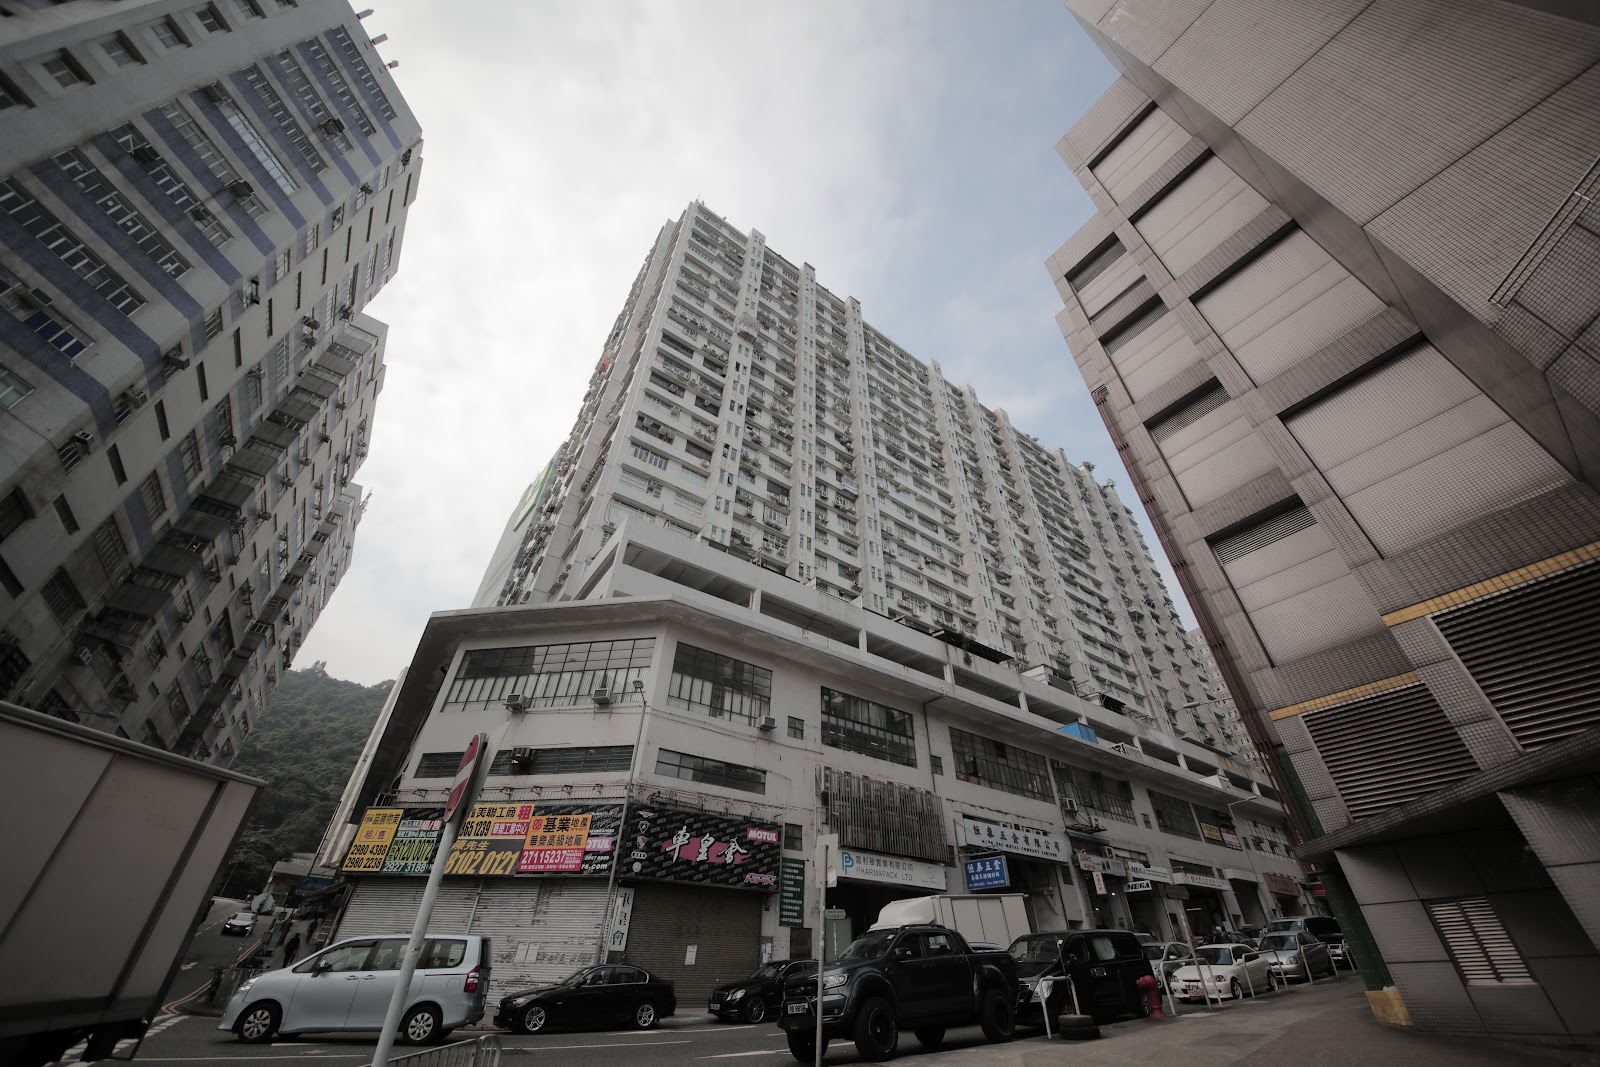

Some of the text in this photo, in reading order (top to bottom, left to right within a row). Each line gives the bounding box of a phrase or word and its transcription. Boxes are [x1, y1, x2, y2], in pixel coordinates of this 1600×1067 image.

[476, 807, 517, 818] 美聯工商
[518, 805, 532, 821] 租
[542, 816, 589, 833] 基業地產
[748, 830, 777, 841] MOTUL
[350, 844, 370, 856] 2980
[585, 839, 610, 849] OTUL
[444, 851, 521, 875] 8102 0121
[521, 850, 567, 864] 27115237
[344, 858, 382, 869] 2980 2238
[383, 862, 405, 872] 2927
[405, 862, 426, 872] 3188
[967, 860, 1002, 874] 恒泰五金
[856, 867, 899, 881] PHARMAPACK
[901, 873, 915, 882] LTD.
[1127, 882, 1151, 891] MEGA
